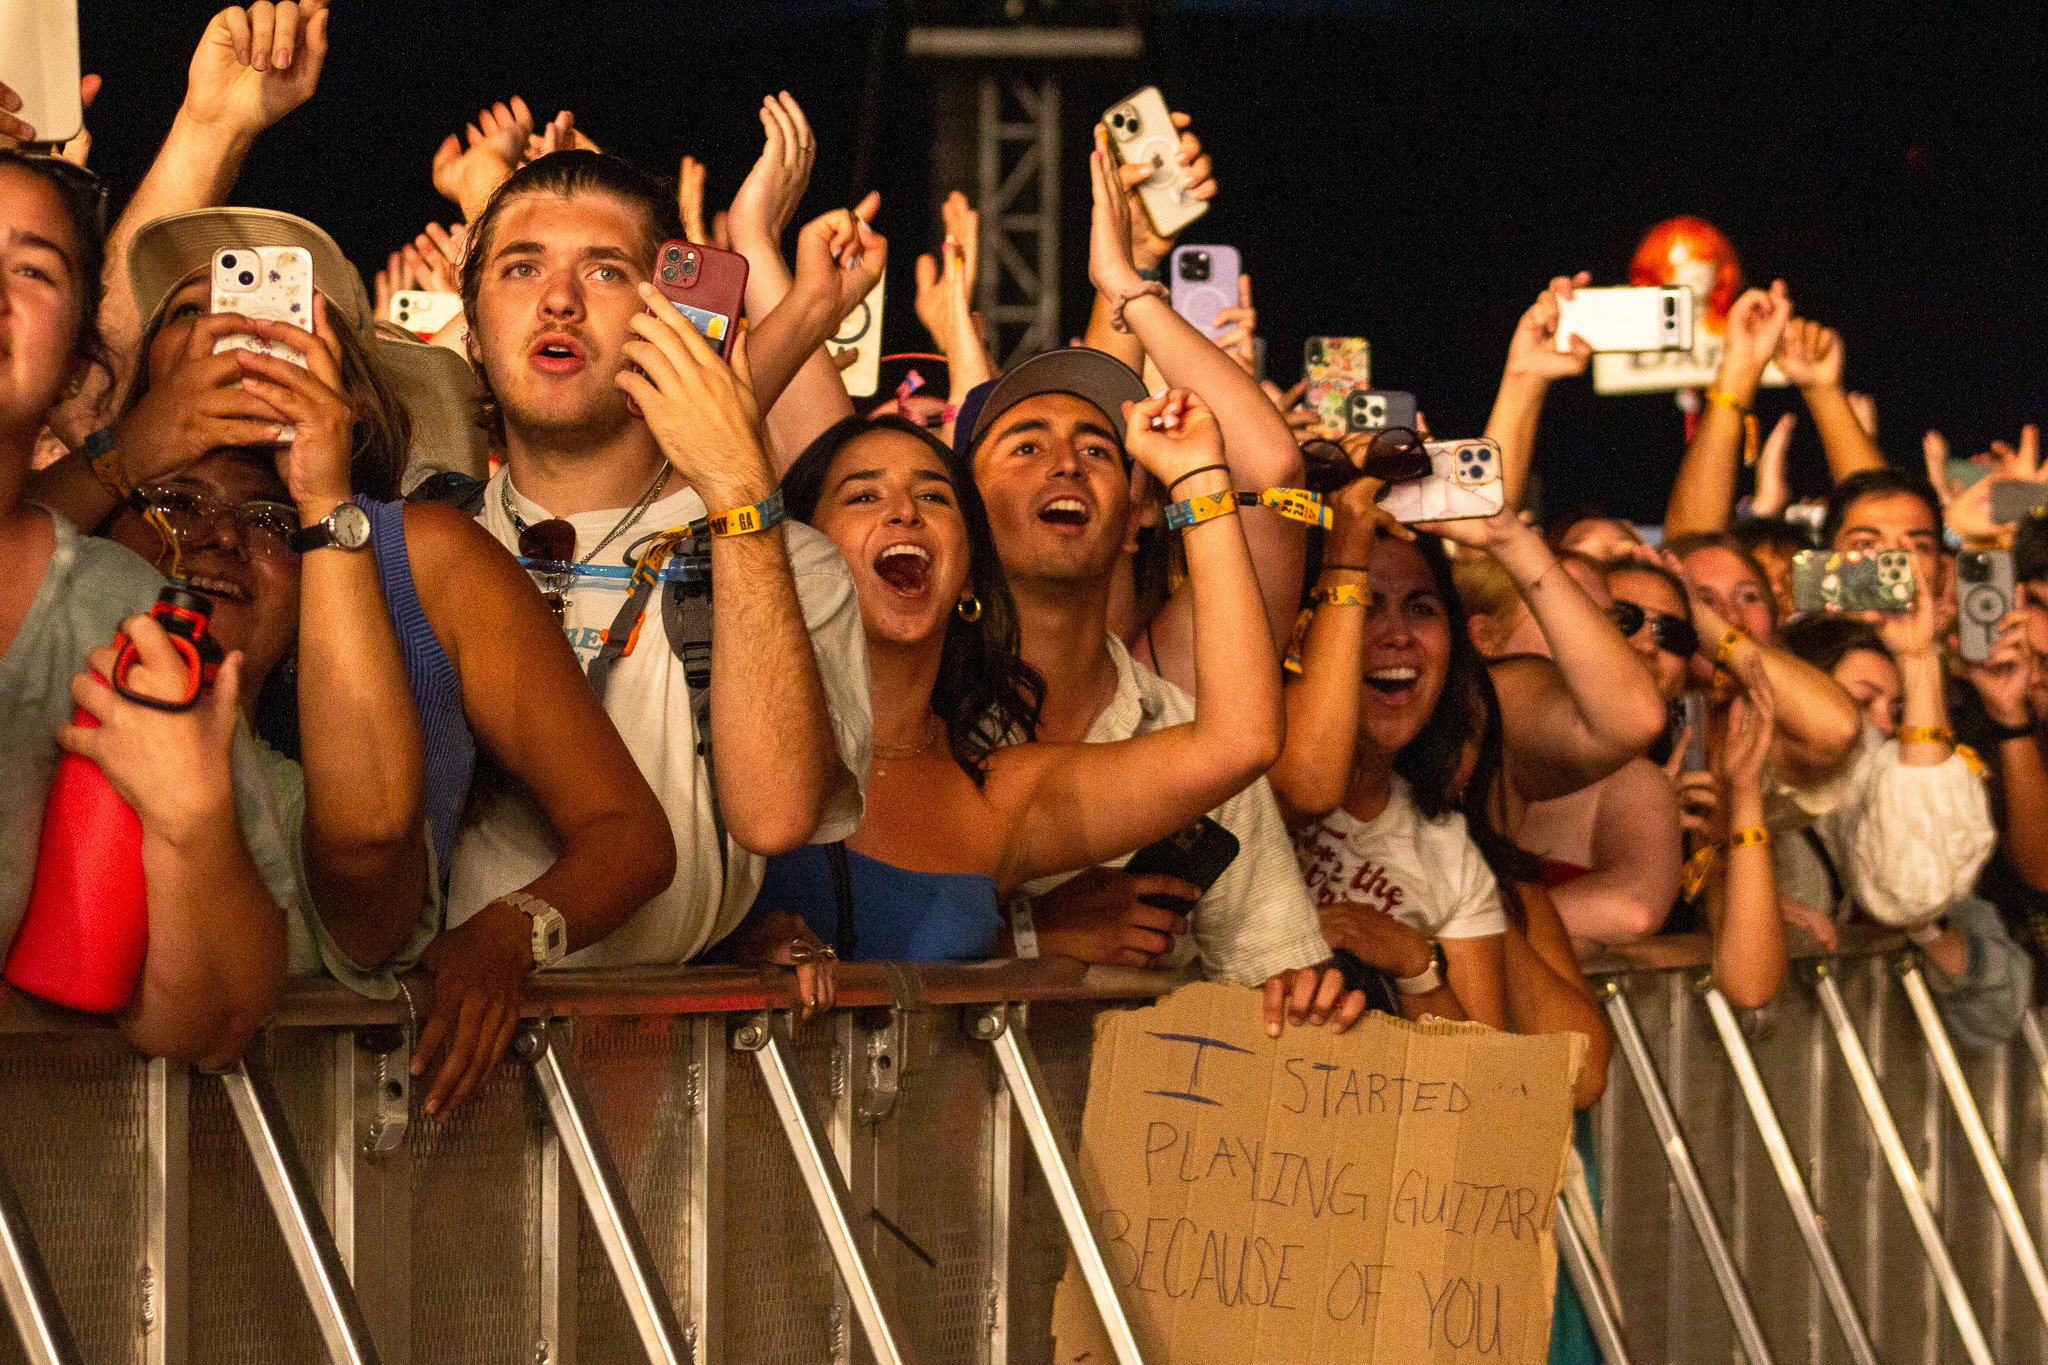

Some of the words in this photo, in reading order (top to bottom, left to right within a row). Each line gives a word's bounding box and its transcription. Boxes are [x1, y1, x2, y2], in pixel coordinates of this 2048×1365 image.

[738, 511, 754, 531] GA
[1144, 1031, 1255, 1107] I
[1281, 1057, 1471, 1118] STARTED
[1145, 1121, 1369, 1221] PLAYING
[1393, 1168, 1541, 1245] GUITAR
[1097, 1209, 1304, 1311] BECAUSE
[1326, 1260, 1395, 1326] OF
[1417, 1270, 1501, 1356] YOU
